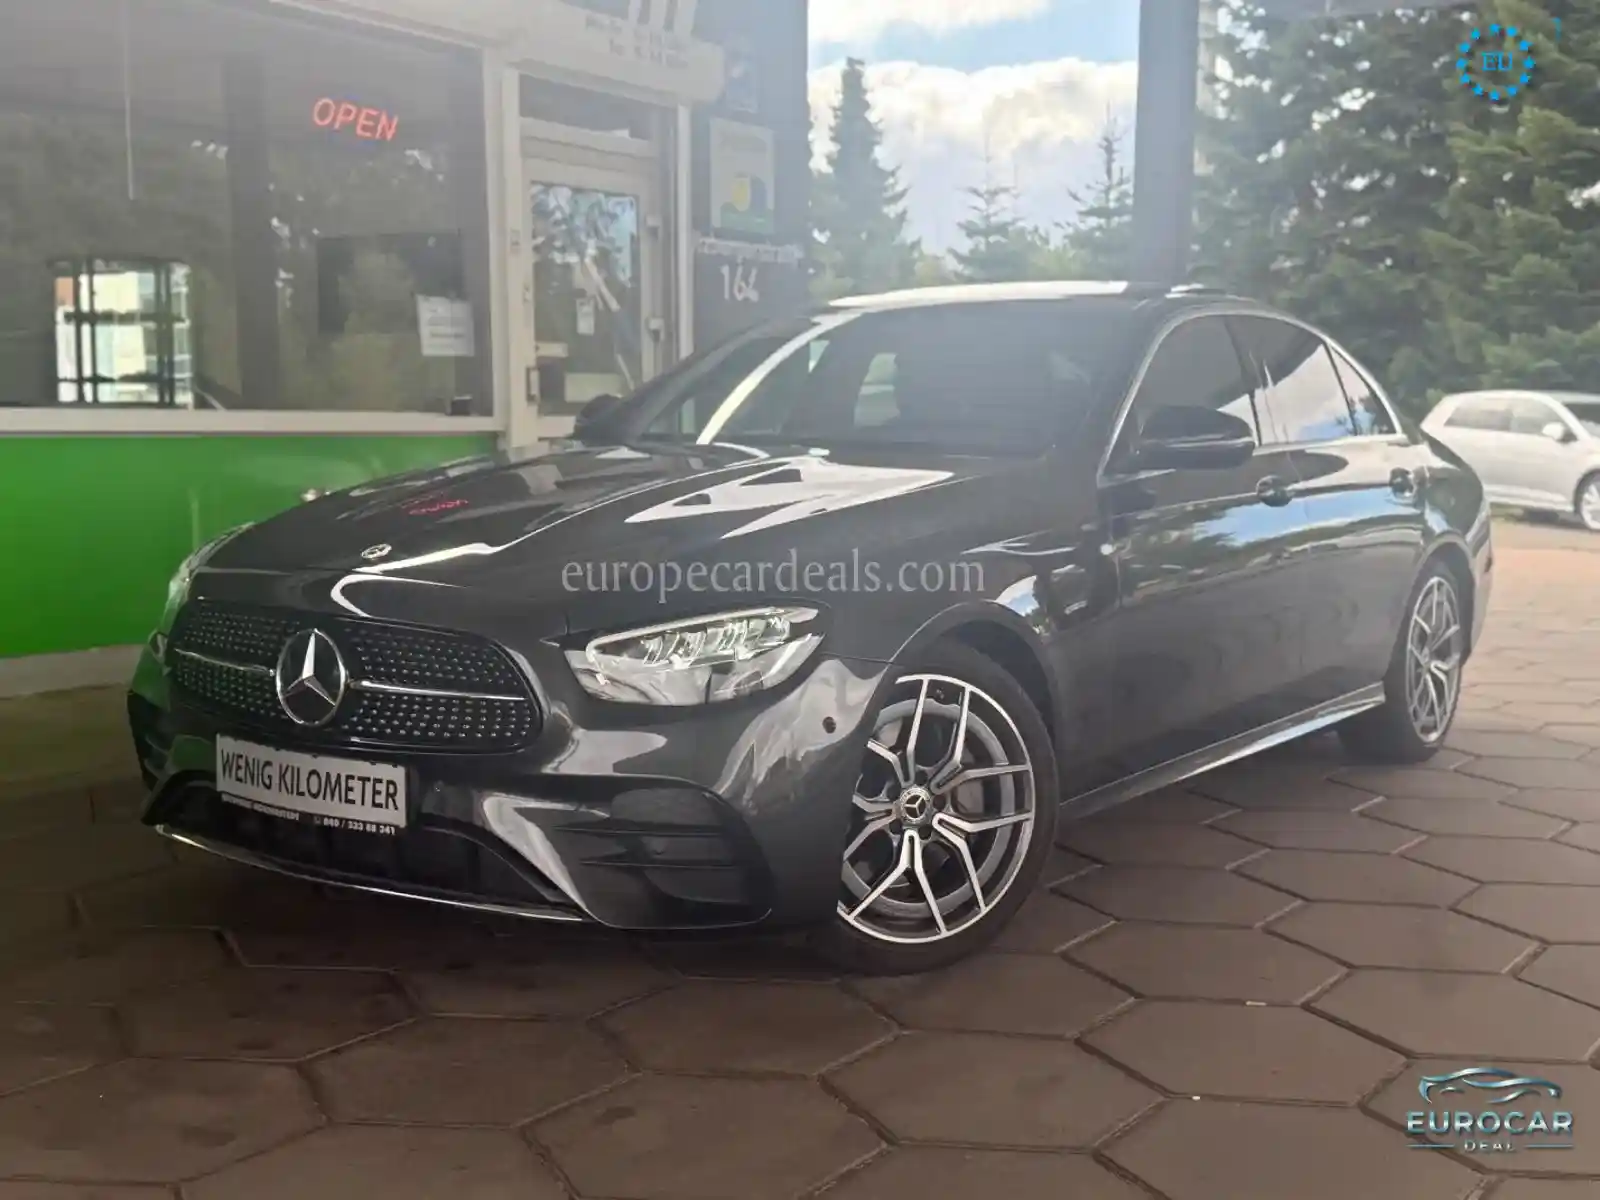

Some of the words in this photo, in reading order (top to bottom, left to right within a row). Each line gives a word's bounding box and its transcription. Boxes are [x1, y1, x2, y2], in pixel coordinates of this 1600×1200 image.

[313, 97, 398, 141] OPEN
[220, 749, 274, 790] WENIG
[279, 763, 400, 811] KILOMETER
